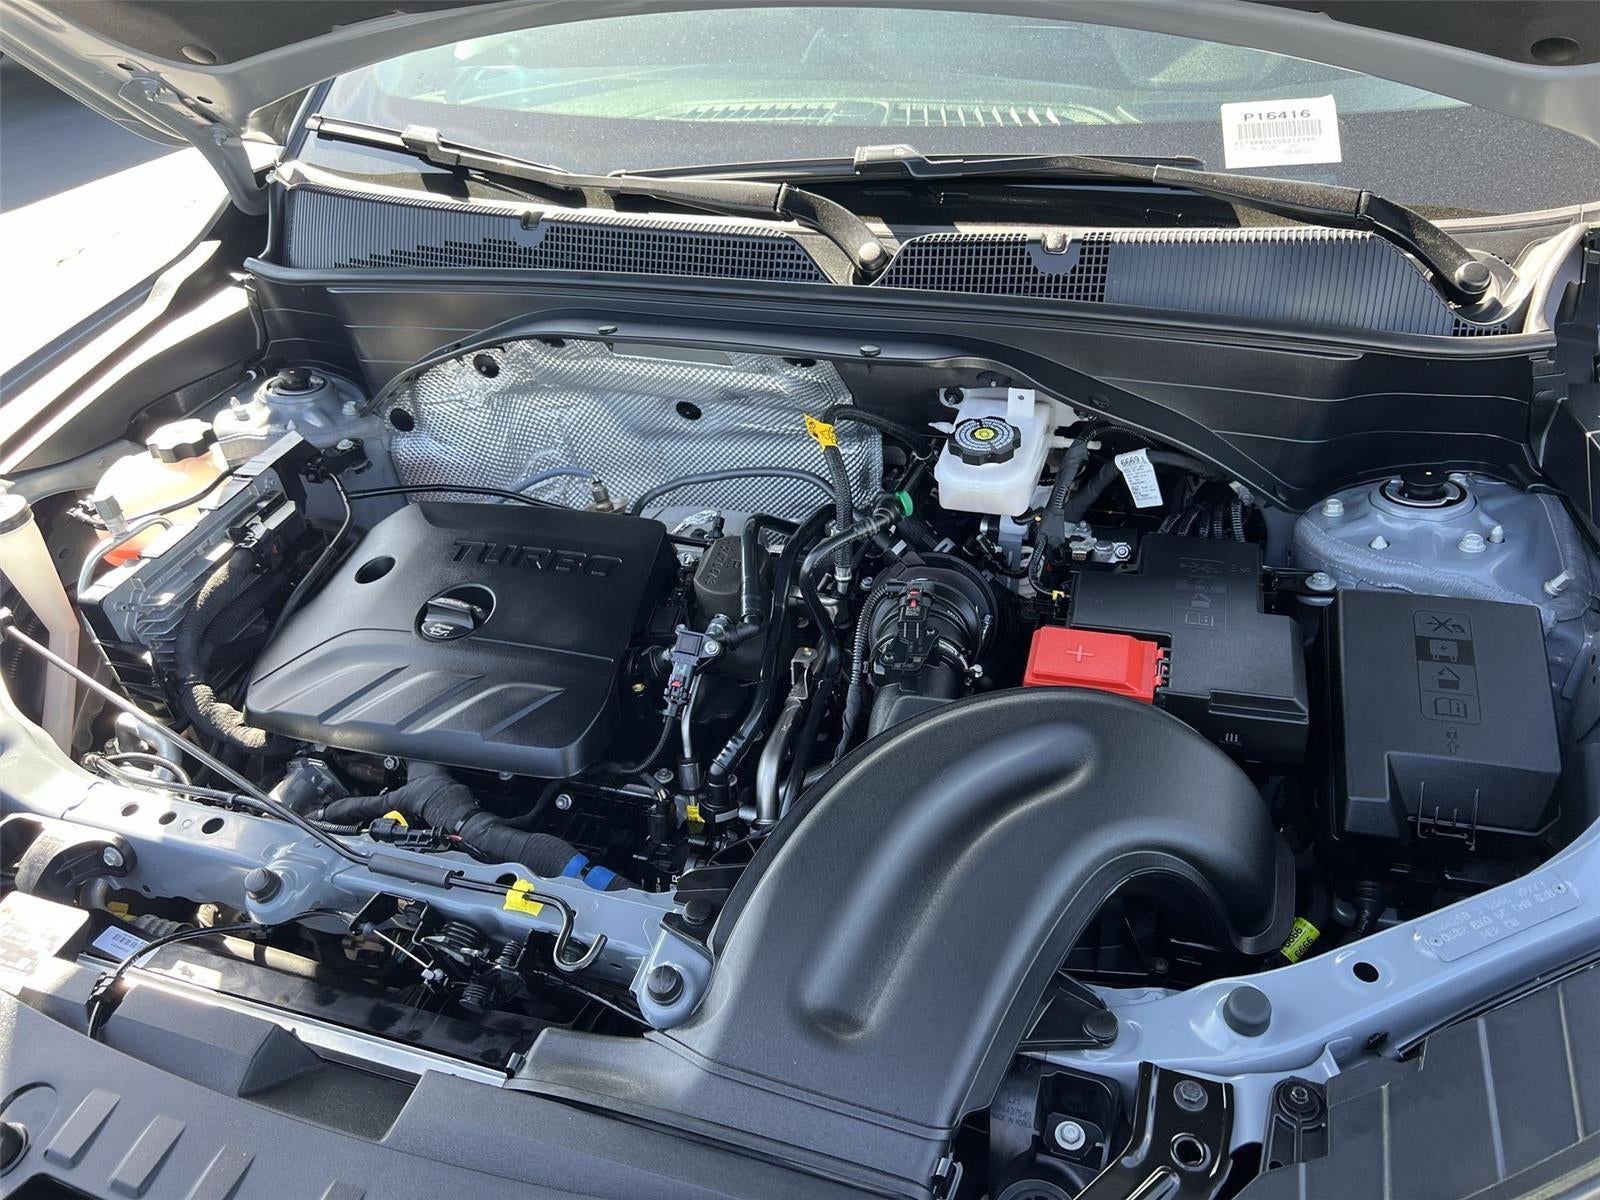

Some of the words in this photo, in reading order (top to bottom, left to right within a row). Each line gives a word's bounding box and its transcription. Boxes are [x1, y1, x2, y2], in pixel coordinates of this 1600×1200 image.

[1243, 109, 1312, 122] P16416
[1120, 455, 1140, 467] 6669
[453, 540, 623, 577] TURBO
